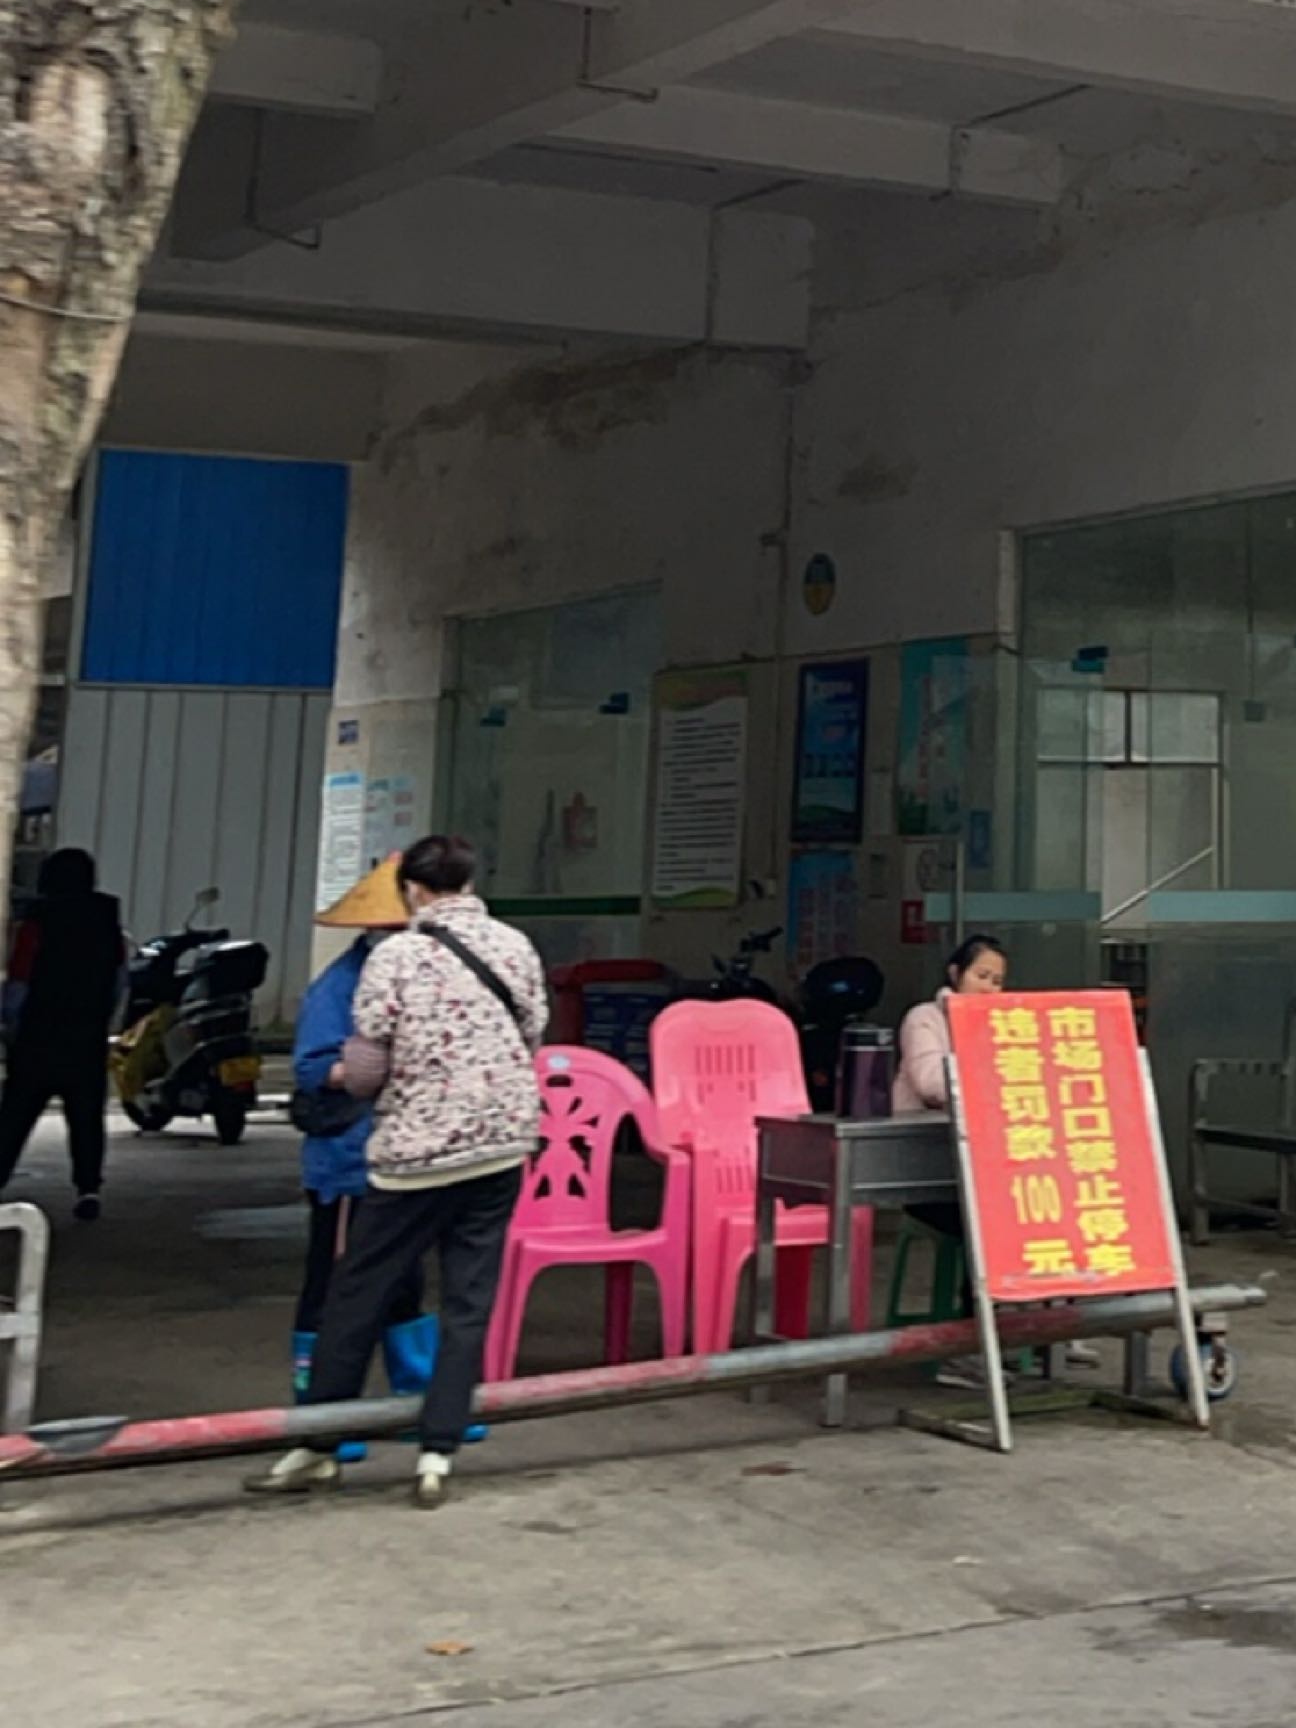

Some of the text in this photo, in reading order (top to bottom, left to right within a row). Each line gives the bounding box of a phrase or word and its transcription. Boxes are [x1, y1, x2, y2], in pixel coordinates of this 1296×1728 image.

[989, 1007, 1076, 1276] 违者罚款100元
[1046, 1006, 1136, 1277] 市场门口禁止停车
